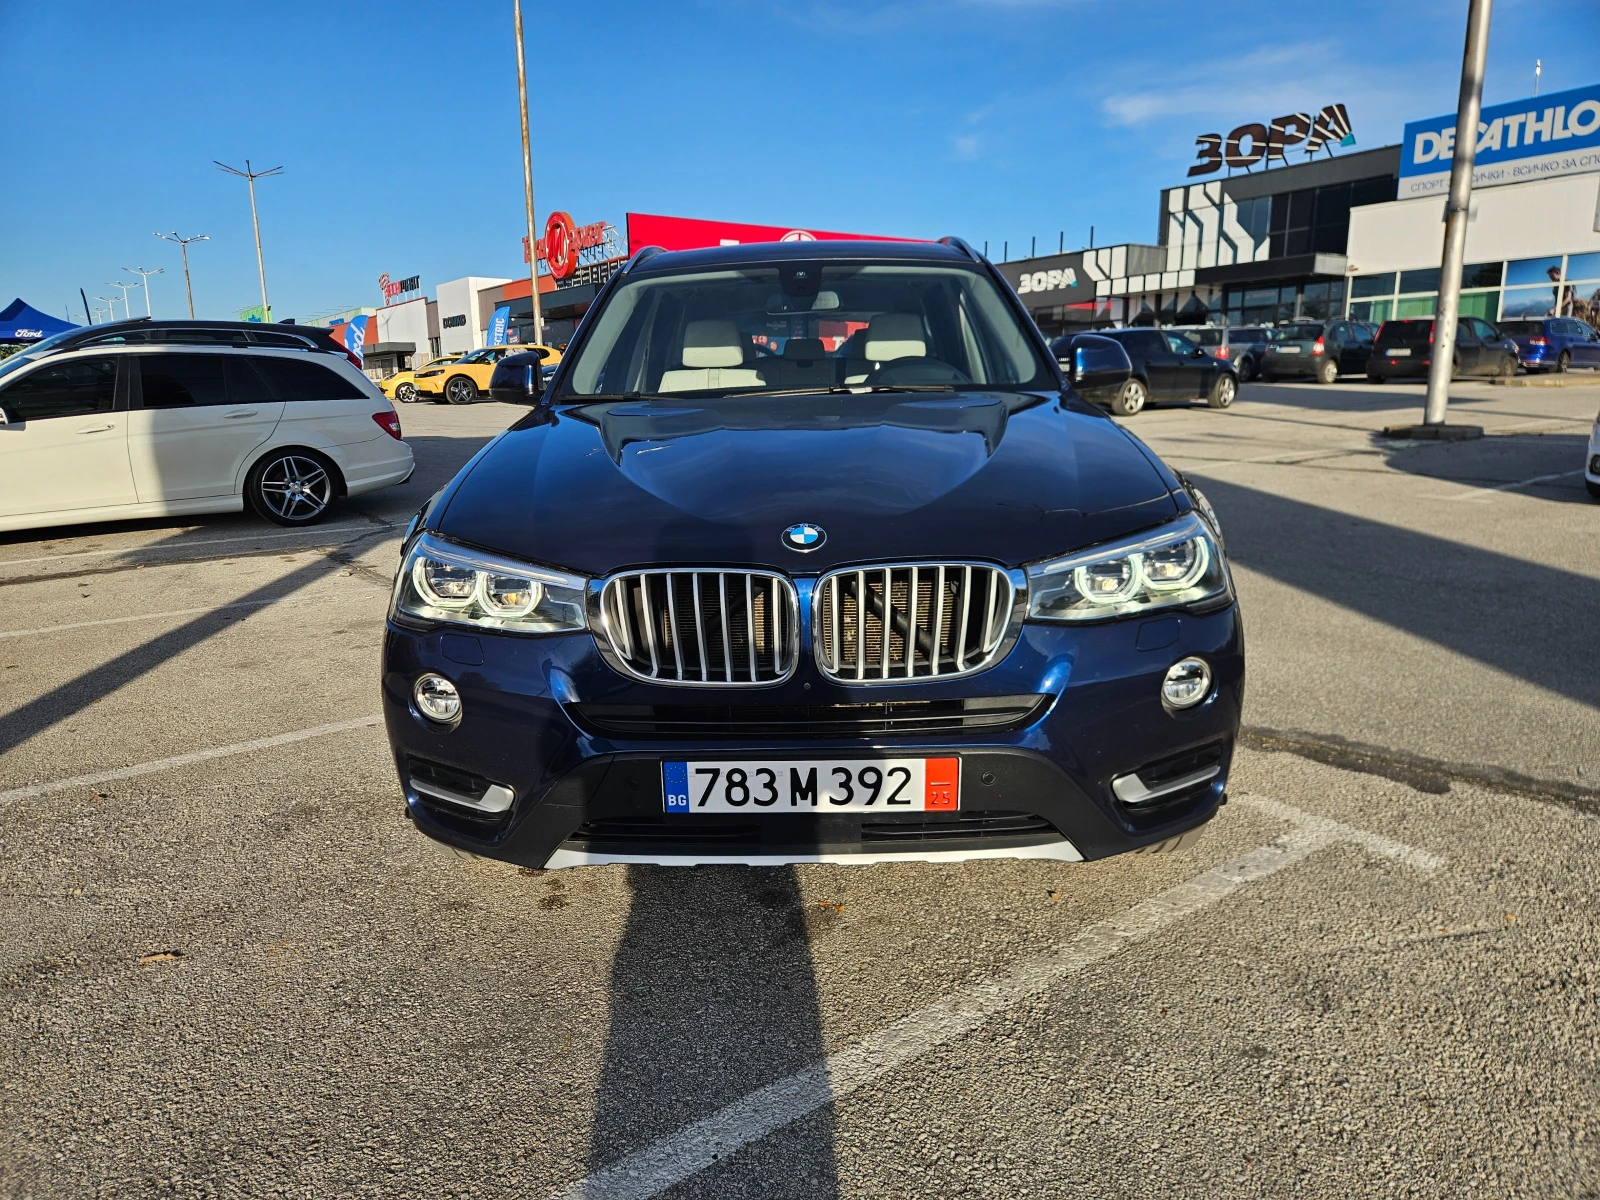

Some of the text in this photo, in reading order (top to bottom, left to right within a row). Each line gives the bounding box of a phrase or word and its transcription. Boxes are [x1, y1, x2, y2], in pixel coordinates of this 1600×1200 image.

[1187, 103, 1356, 177] ЗОРА
[1410, 178, 1444, 193] СПОРТ
[1513, 160, 1560, 177] ВСИЧКО
[1562, 158, 1577, 169] ЗА
[1580, 153, 1600, 167] СП
[1017, 267, 1078, 294] ЗОРА
[15, 328, 43, 338] Ford
[667, 794, 687, 806] BG
[695, 766, 912, 807] 783 M 392
[931, 791, 950, 805] 25
